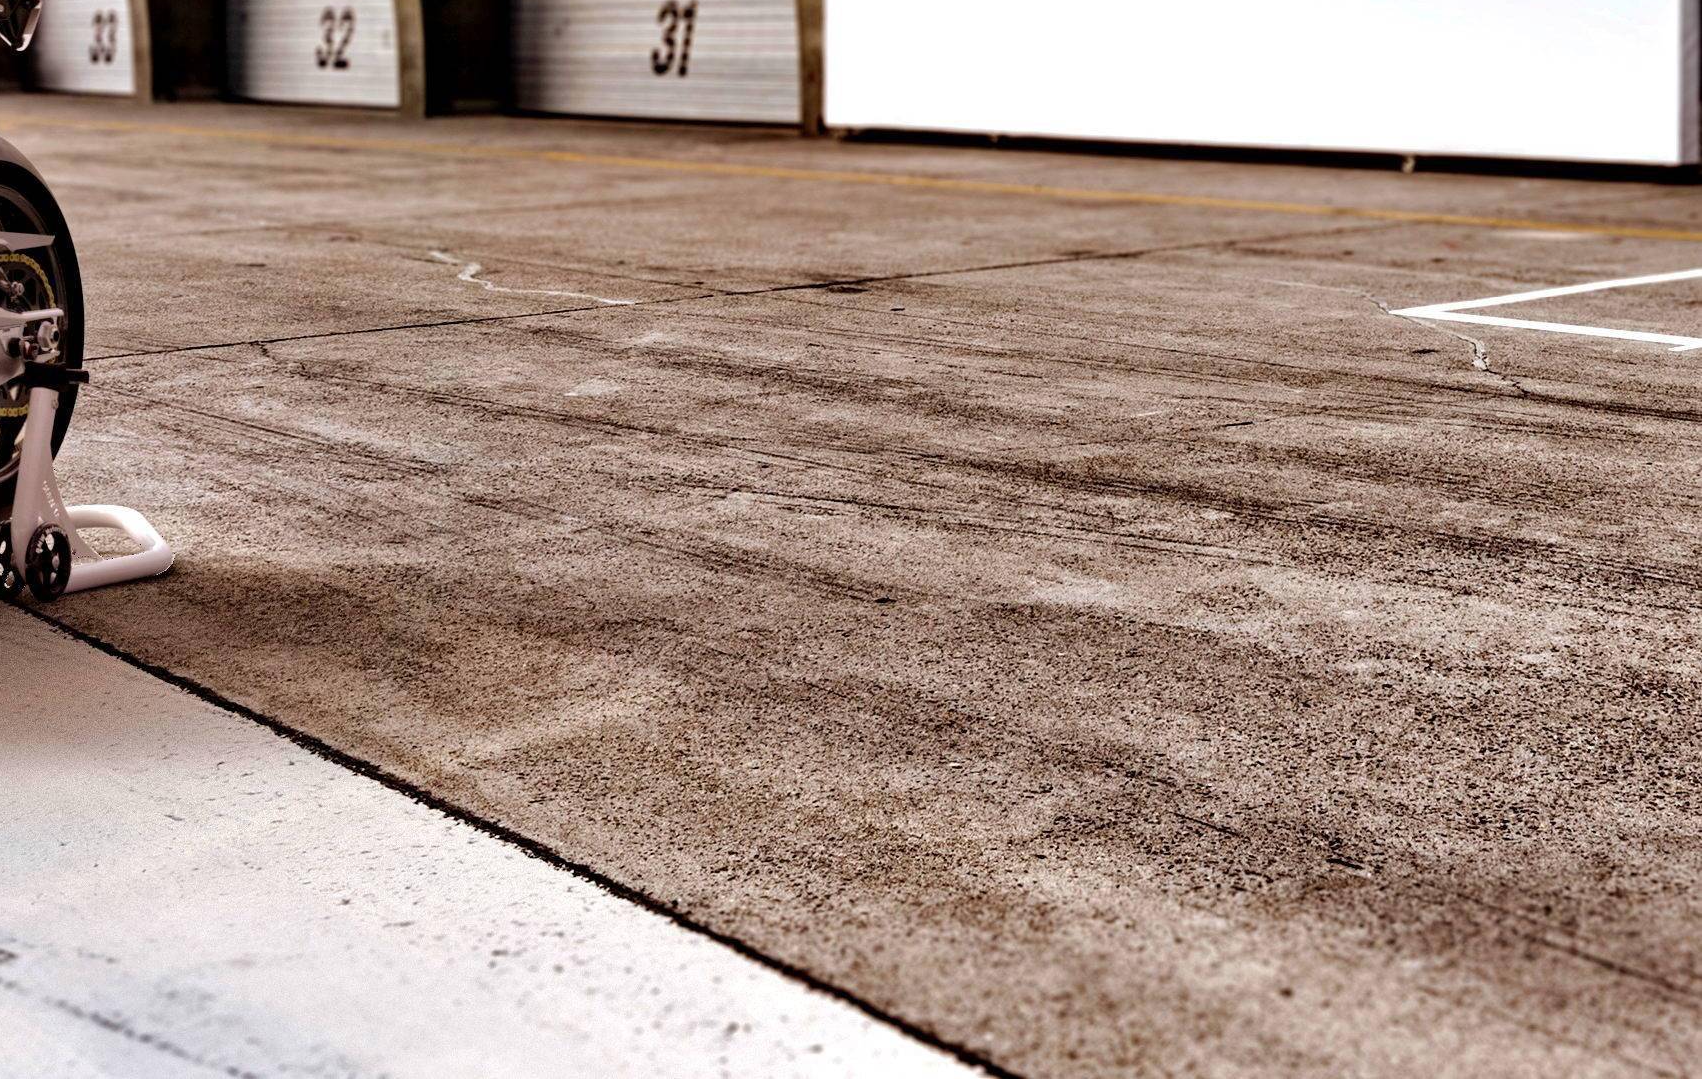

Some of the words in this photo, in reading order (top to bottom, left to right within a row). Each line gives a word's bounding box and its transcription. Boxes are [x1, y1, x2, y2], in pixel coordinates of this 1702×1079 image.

[89, 9, 118, 64] 33
[315, 6, 356, 70] 32
[651, 0, 699, 77] 31
